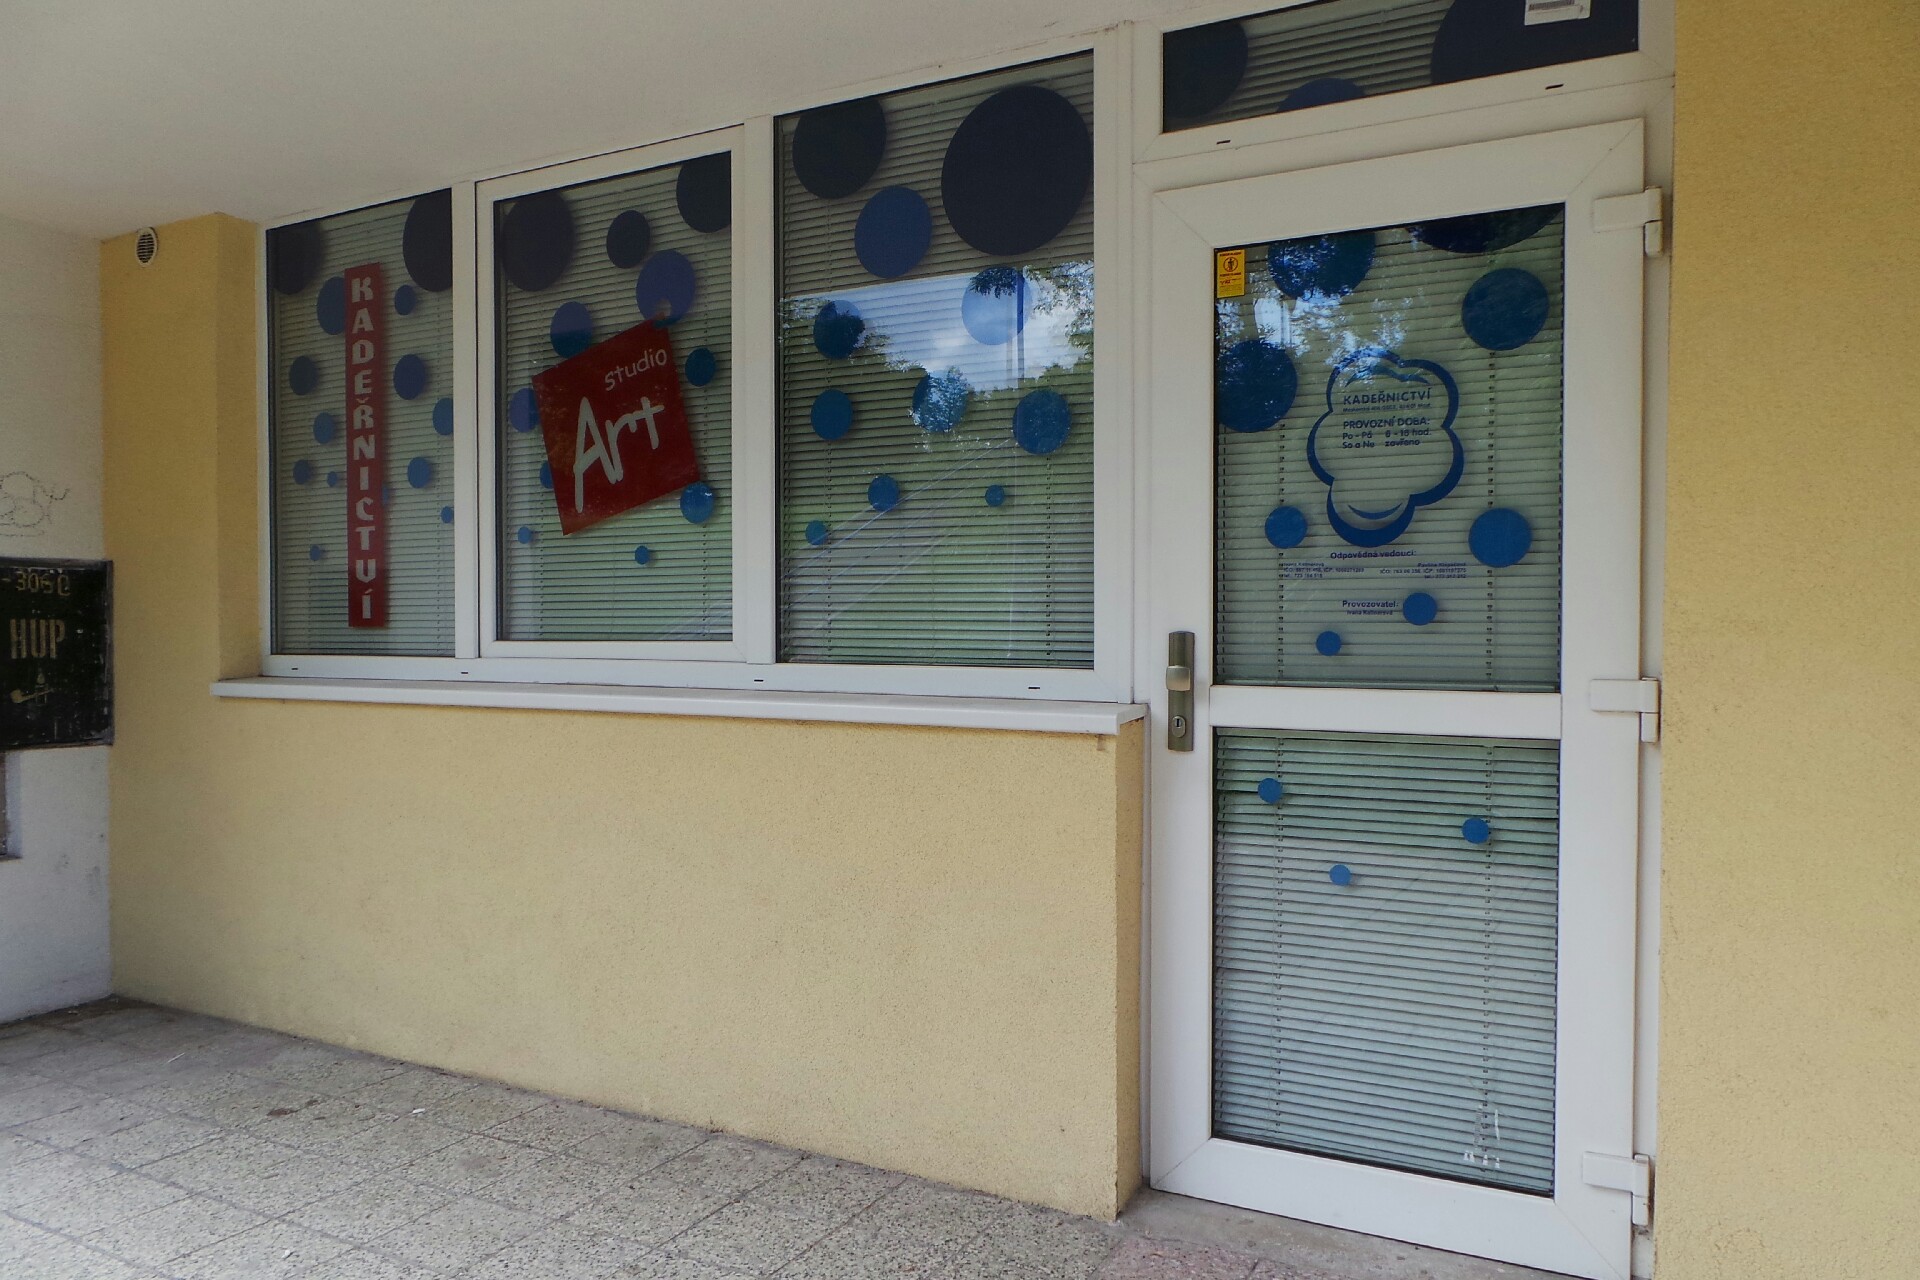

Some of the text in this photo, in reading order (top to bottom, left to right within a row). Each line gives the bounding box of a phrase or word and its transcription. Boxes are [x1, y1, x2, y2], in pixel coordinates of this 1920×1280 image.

[604, 348, 668, 391] studio
[1343, 387, 1432, 405] KADEŘNICTVÍ
[1343, 415, 1431, 429] PROVOZNÍ DOBA:
[1343, 432, 1353, 440] Po
[1342, 441, 1353, 449] So
[1384, 439, 1420, 447] zavřeno
[573, 396, 665, 514] Art
[1330, 551, 1378, 560] Odpovědná
[1342, 600, 1399, 608] Provozovatel:
[10, 618, 66, 660] HUP
